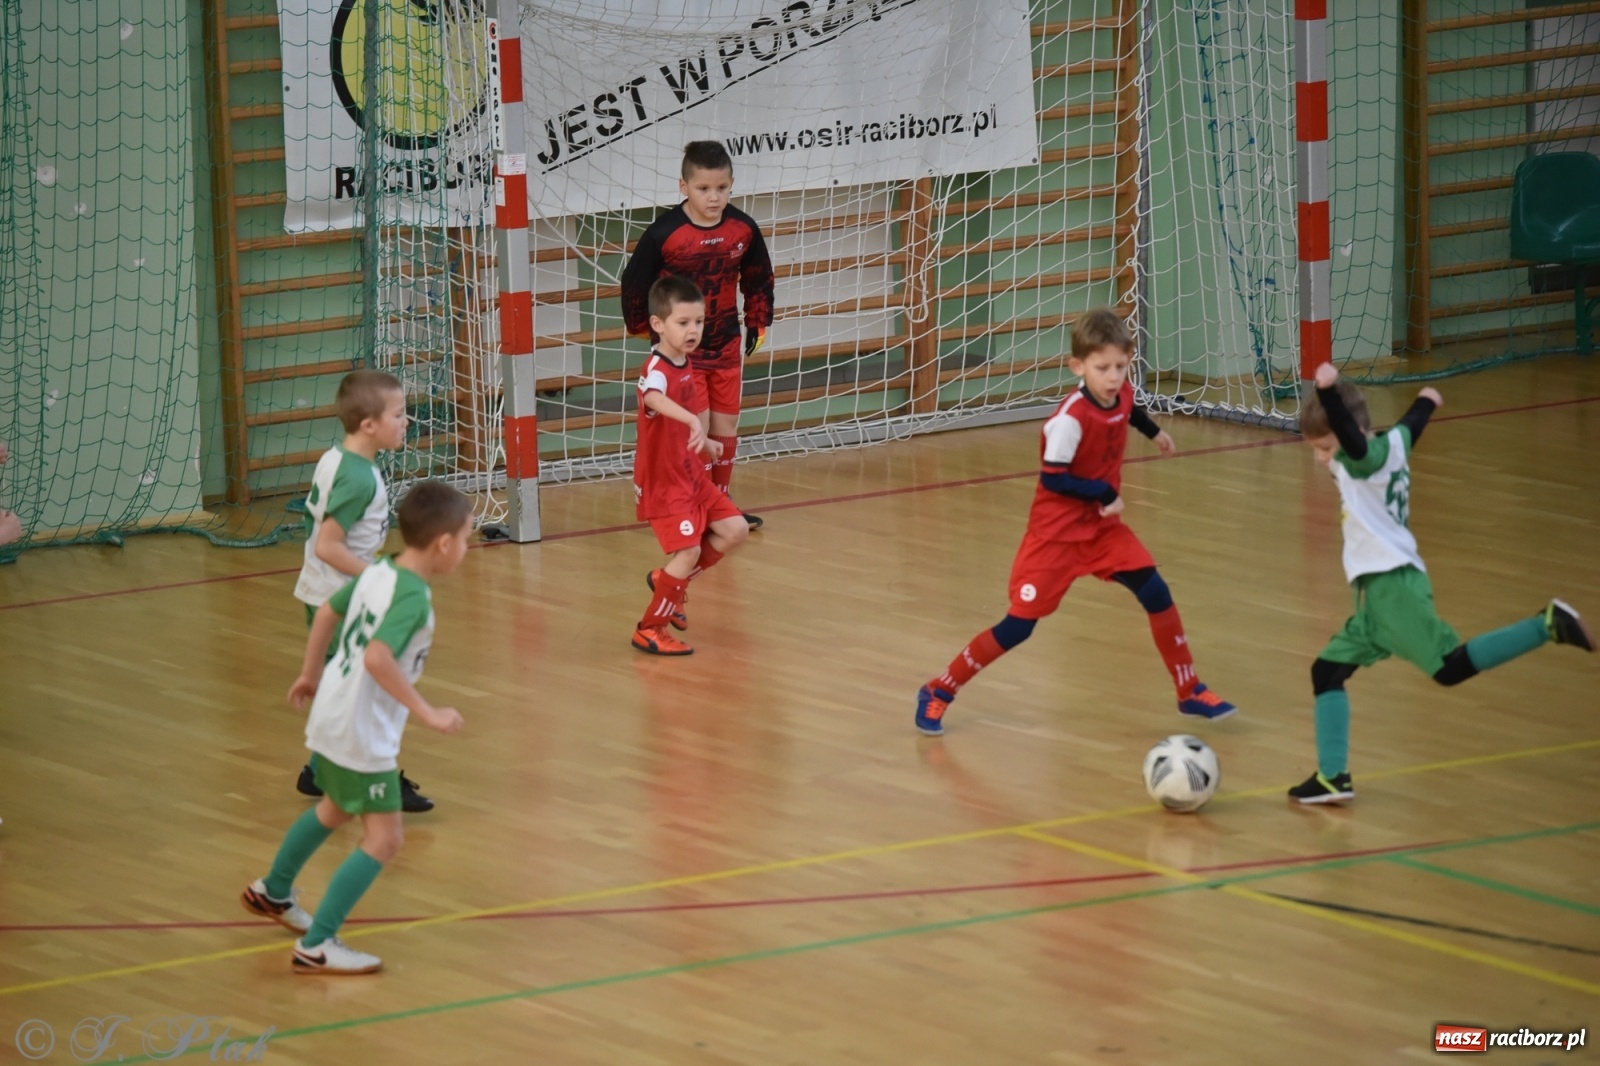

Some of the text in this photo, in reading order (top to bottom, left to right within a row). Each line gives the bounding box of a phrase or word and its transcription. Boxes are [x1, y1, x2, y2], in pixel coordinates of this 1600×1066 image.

[537, 75, 647, 165] JEST
[659, 49, 709, 104] W
[727, 103, 997, 157] www.osir-raciborz.pl
